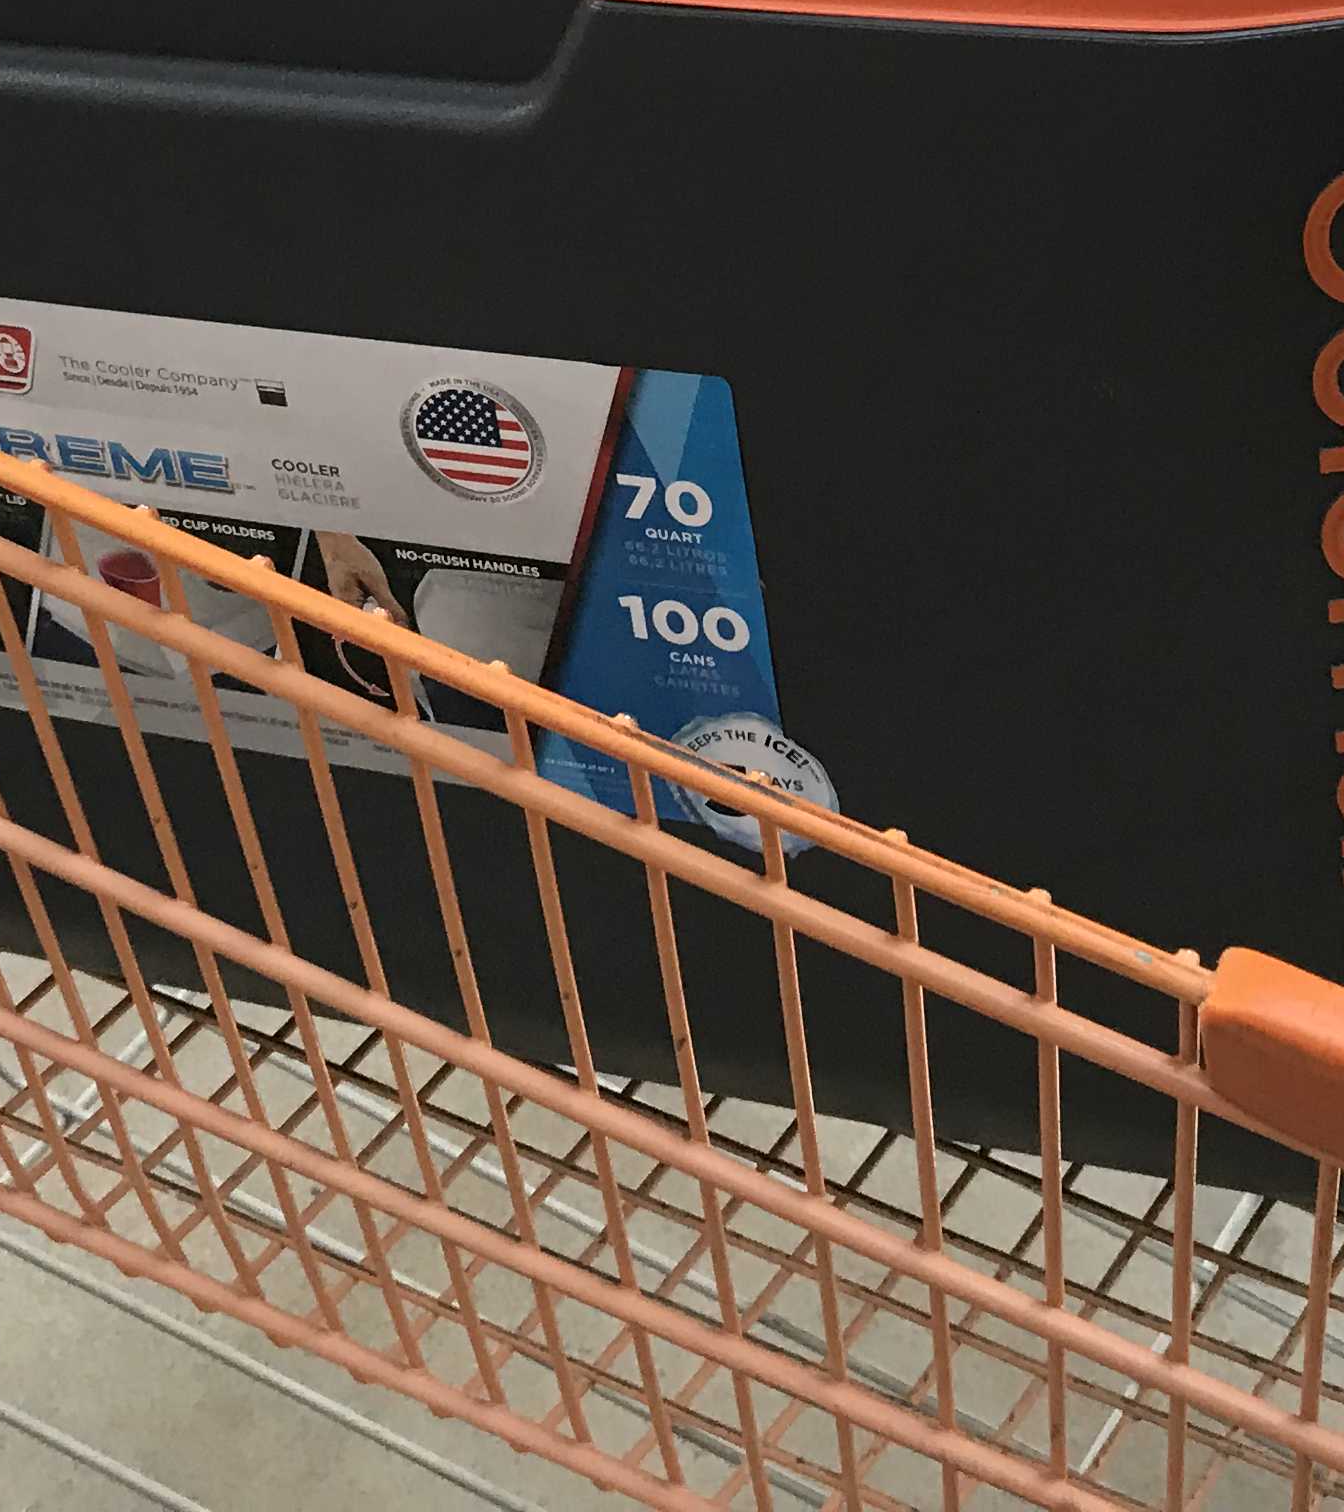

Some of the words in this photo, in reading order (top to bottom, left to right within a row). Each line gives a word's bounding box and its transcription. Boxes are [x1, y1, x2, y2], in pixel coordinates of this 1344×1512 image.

[59, 355, 90, 371] The
[95, 360, 150, 378] Cooler
[271, 458, 340, 478] COOLER
[5, 494, 26, 506] LID
[616, 473, 713, 527] 70
[182, 519, 209, 531] CUP
[212, 523, 275, 541] HOLDERS
[645, 528, 703, 544] QUART
[395, 548, 470, 568] NO-CRUSH
[472, 559, 540, 578] HANDLES
[618, 595, 750, 652] 100
[669, 651, 716, 667] CANS
[687, 730, 723, 752] EEPS
[724, 729, 756, 743] THE
[764, 734, 810, 769] ICE!
[771, 776, 804, 792] AYS
